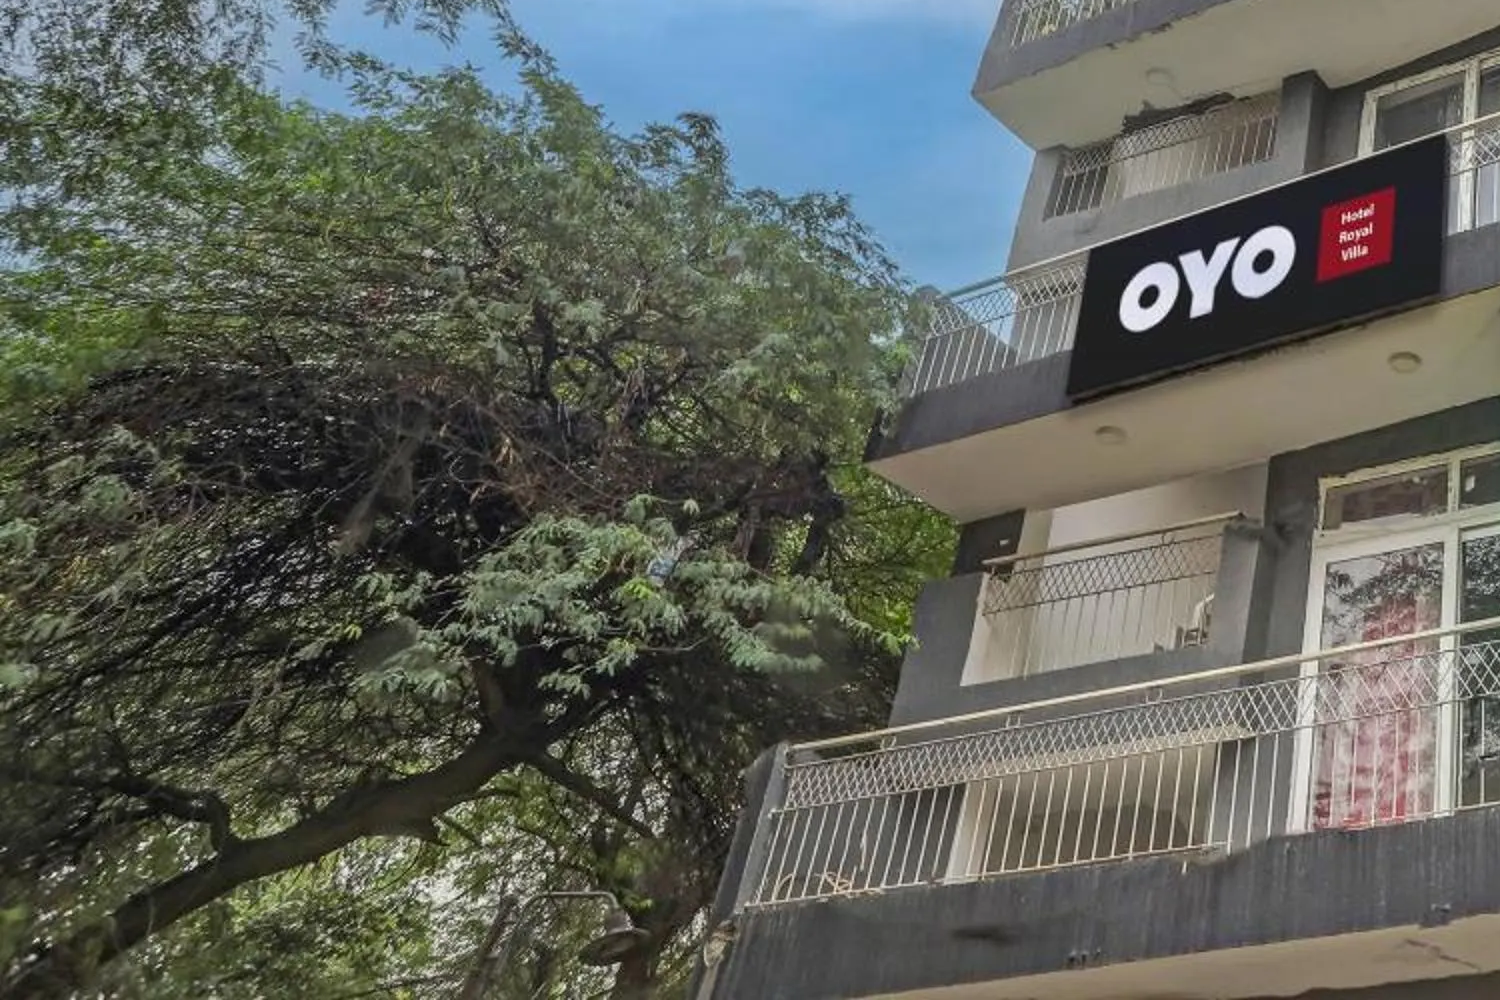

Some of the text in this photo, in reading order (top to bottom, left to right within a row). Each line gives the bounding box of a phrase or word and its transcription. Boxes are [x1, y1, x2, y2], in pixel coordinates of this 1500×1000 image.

[1341, 203, 1375, 225] Hotel
[1339, 222, 1373, 244] Royal
[1341, 244, 1369, 261] Villa
[1119, 225, 1297, 333] OYO
